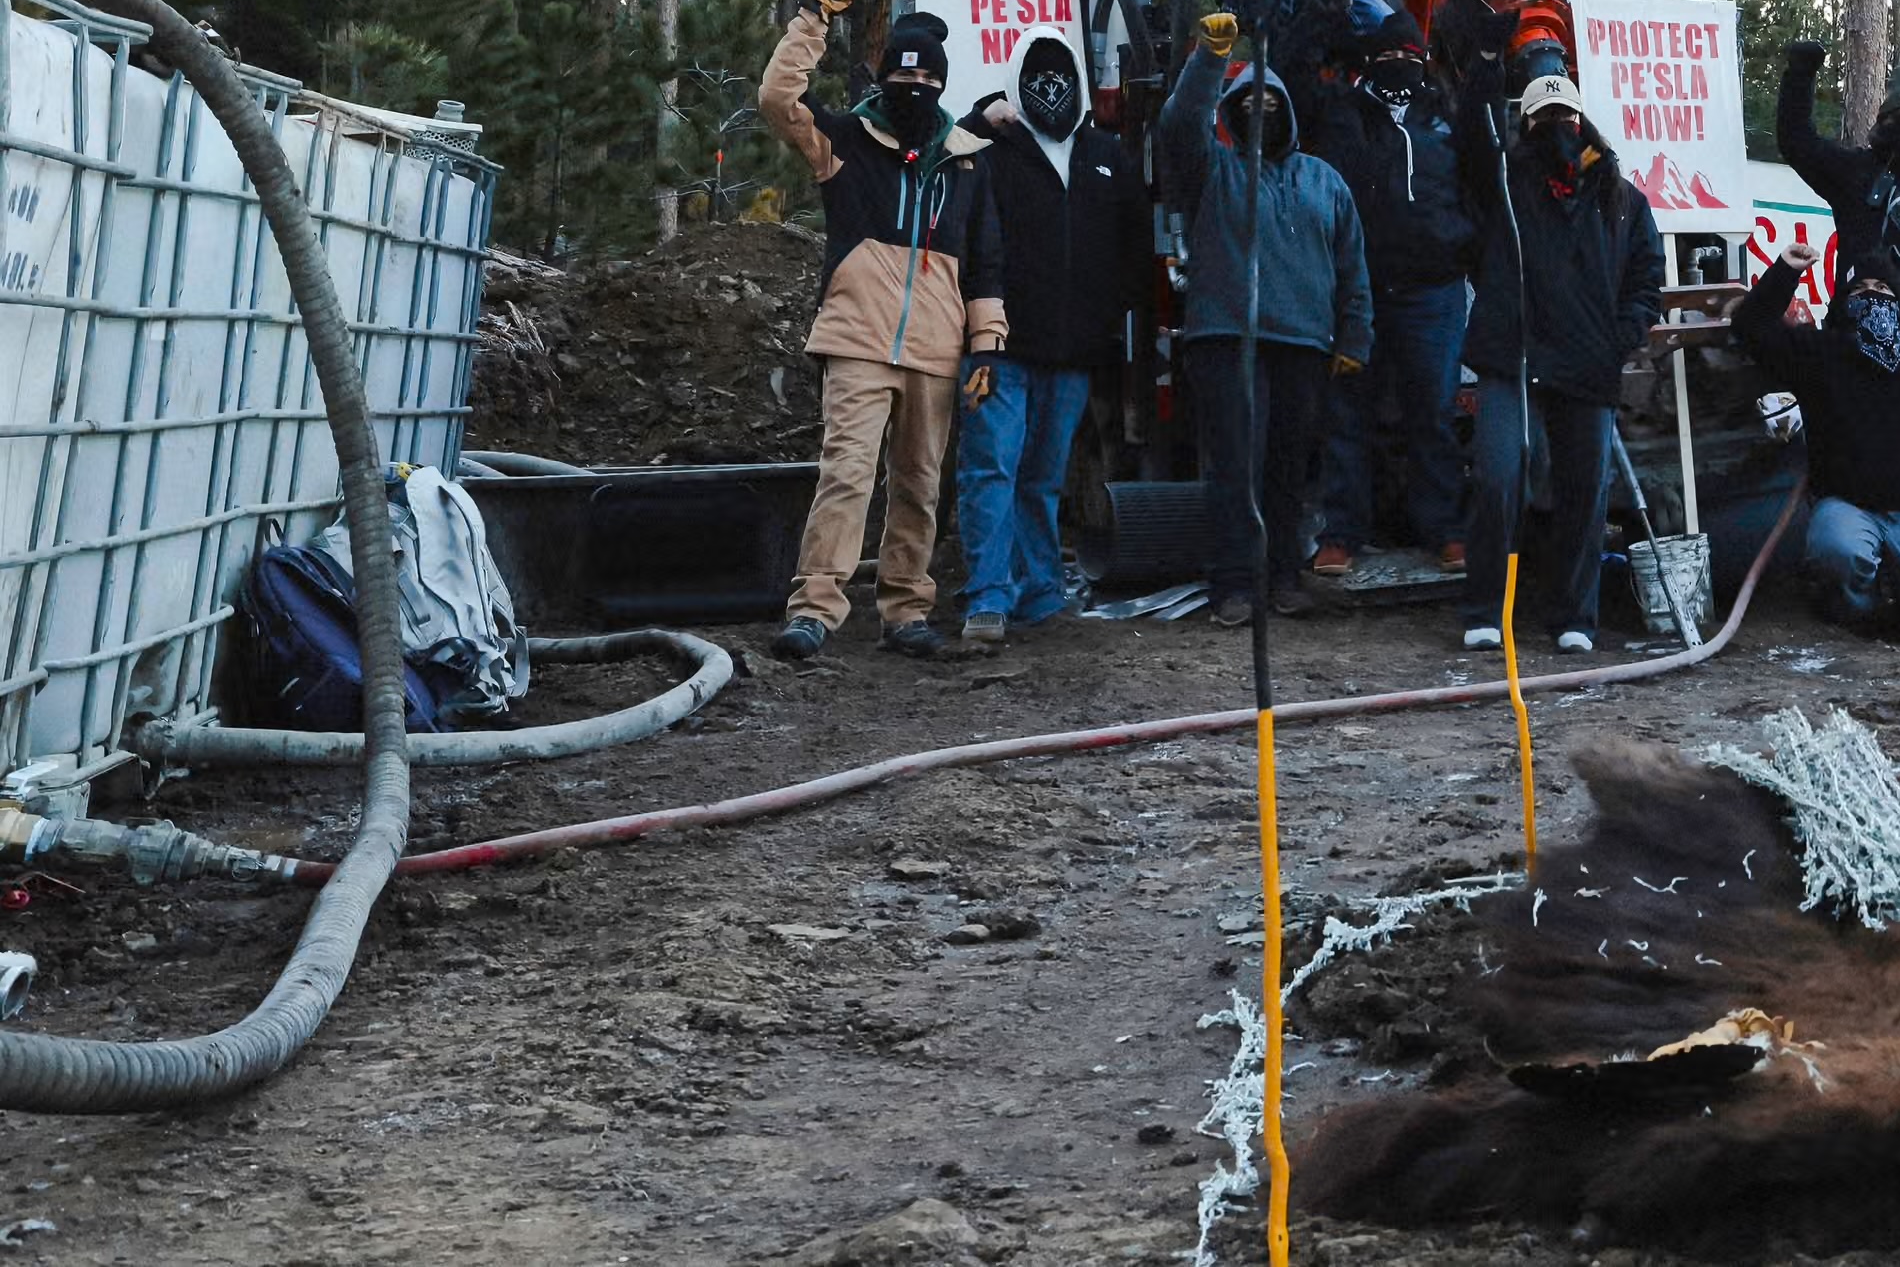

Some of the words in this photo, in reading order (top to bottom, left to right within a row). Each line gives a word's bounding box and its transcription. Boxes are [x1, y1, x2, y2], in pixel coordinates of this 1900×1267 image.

[1586, 17, 1720, 61] PROTECT
[1611, 61, 1709, 101] PE'SLA
[1622, 103, 1705, 142] NOW!
